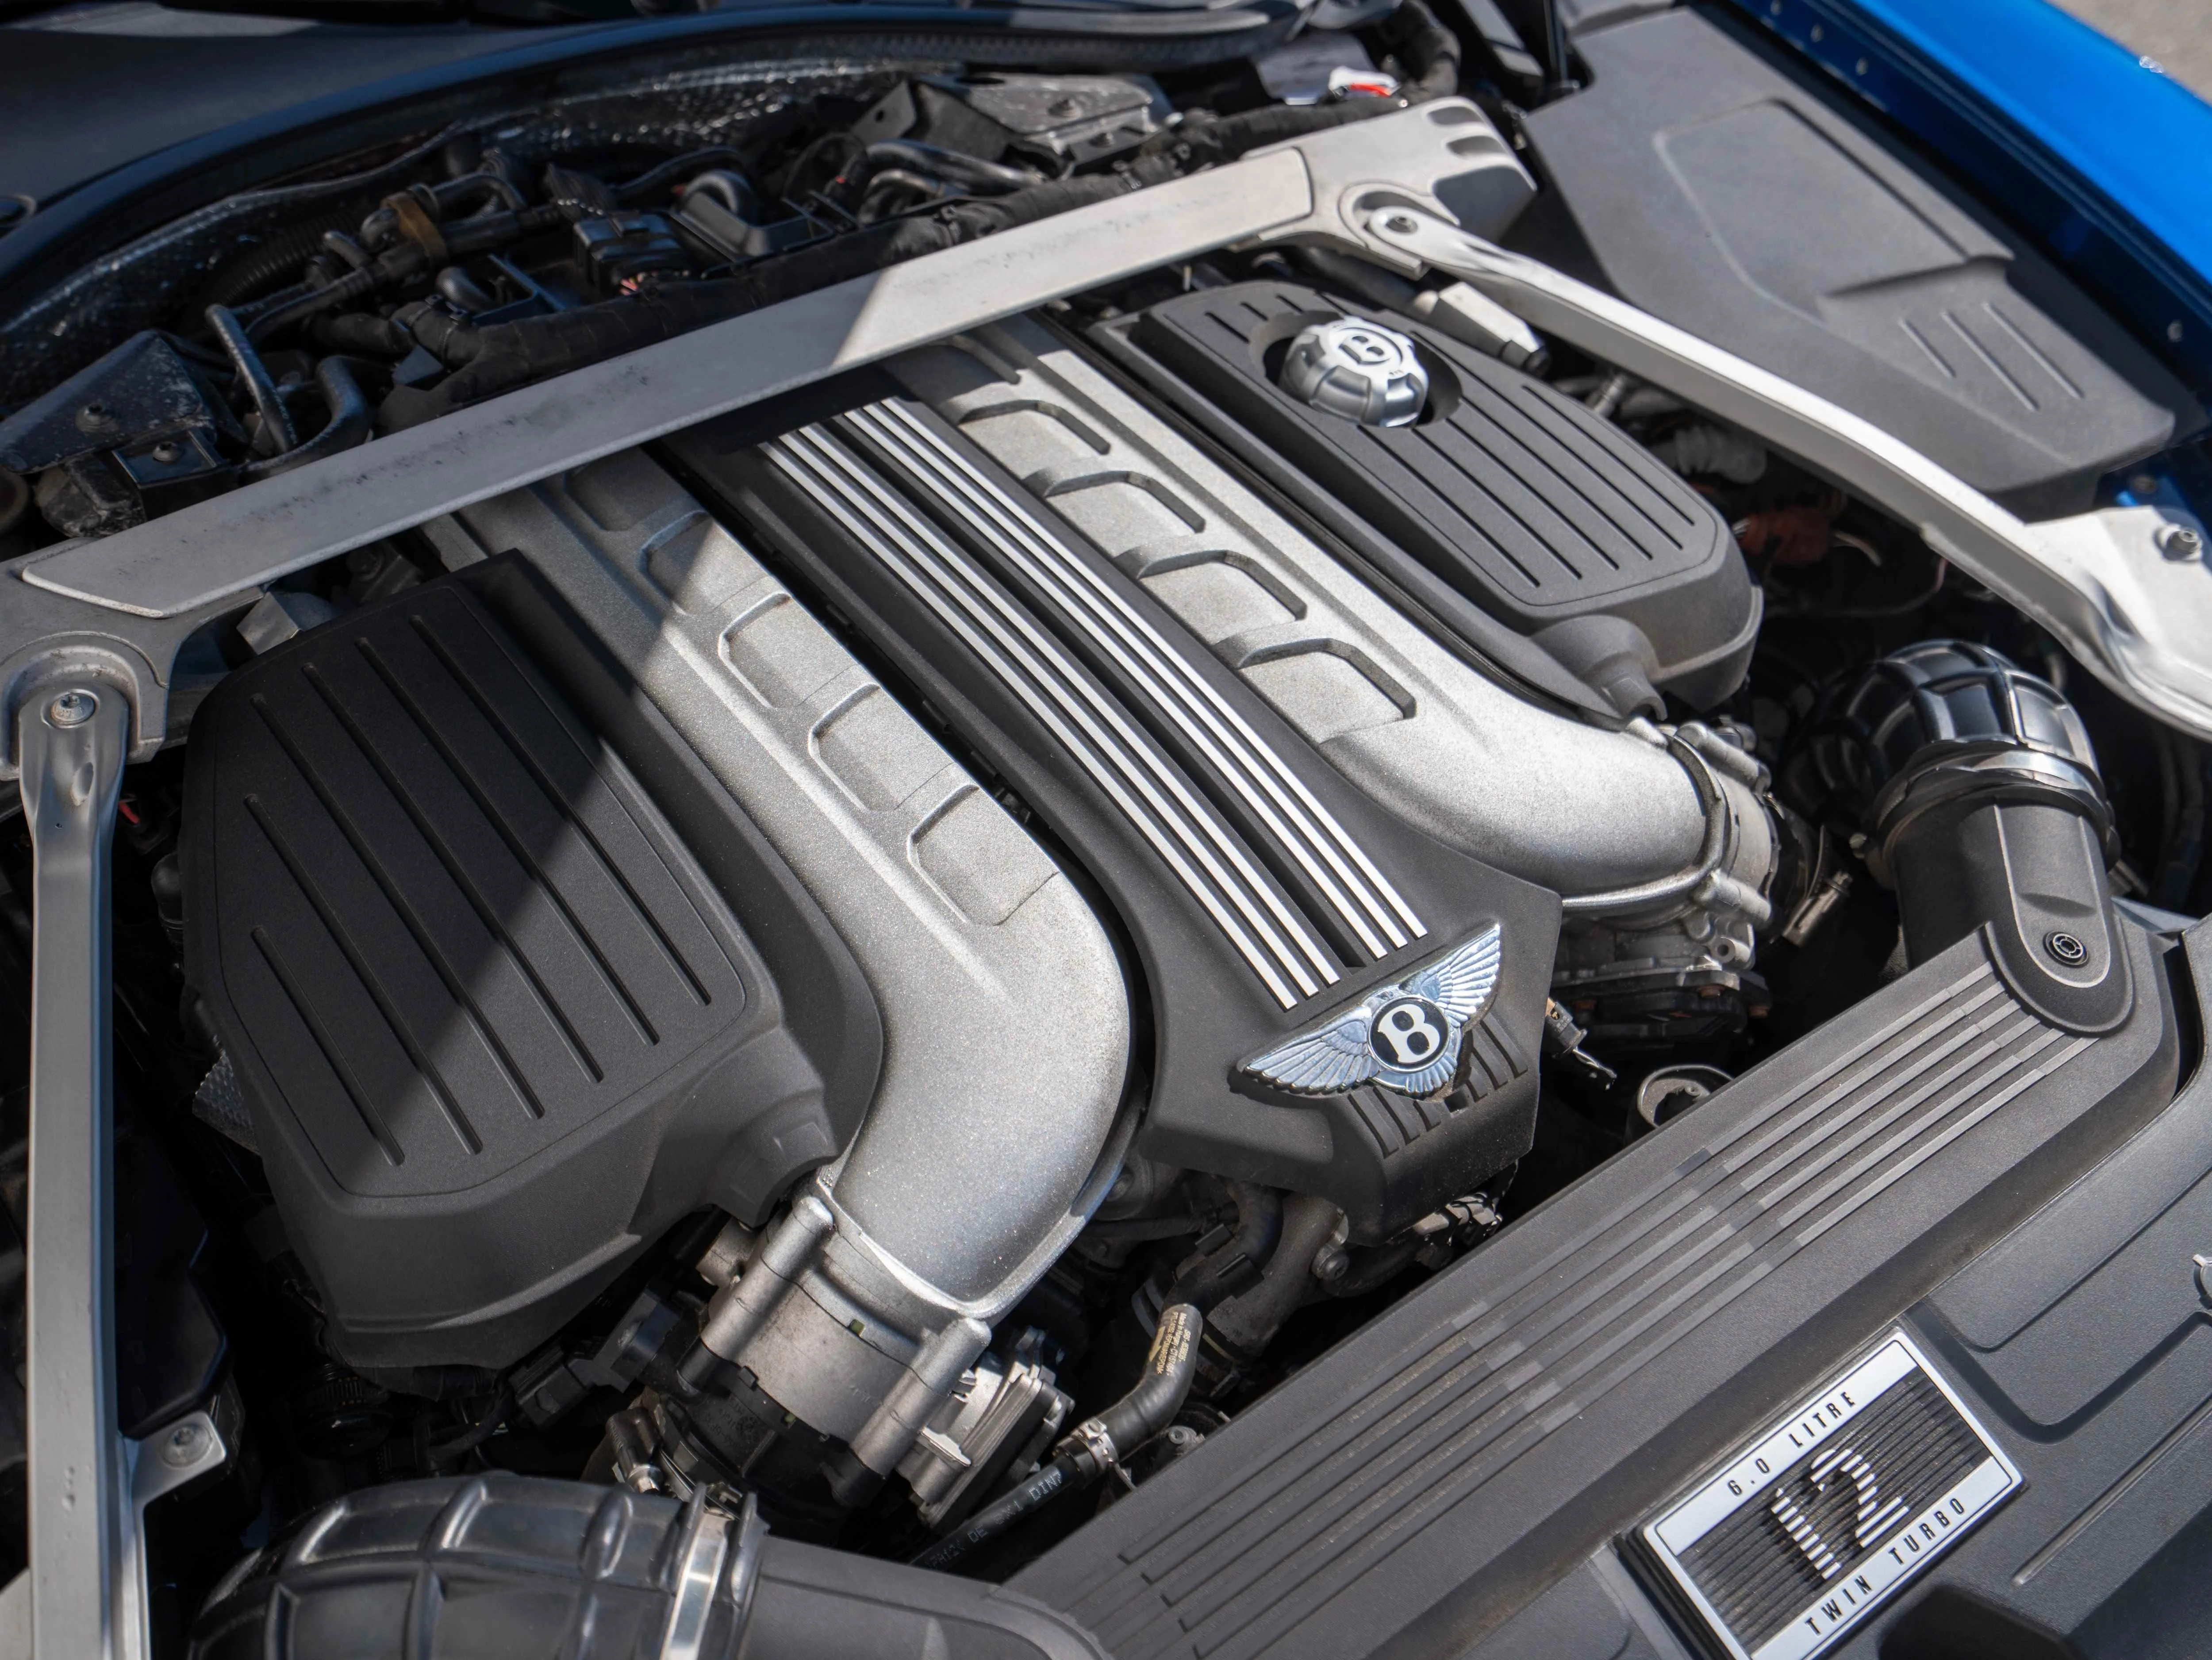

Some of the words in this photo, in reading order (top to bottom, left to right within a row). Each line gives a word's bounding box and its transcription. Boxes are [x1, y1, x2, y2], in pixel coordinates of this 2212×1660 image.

[1377, 1004, 1440, 1064] B
[1727, 1457, 1770, 1496] 6.0
[1788, 1391, 1856, 1449] LITRE
[1771, 1449, 1909, 1579] 12
[1805, 1573, 1873, 1637] TWIN
[1889, 1497, 1965, 1566] TURBO
